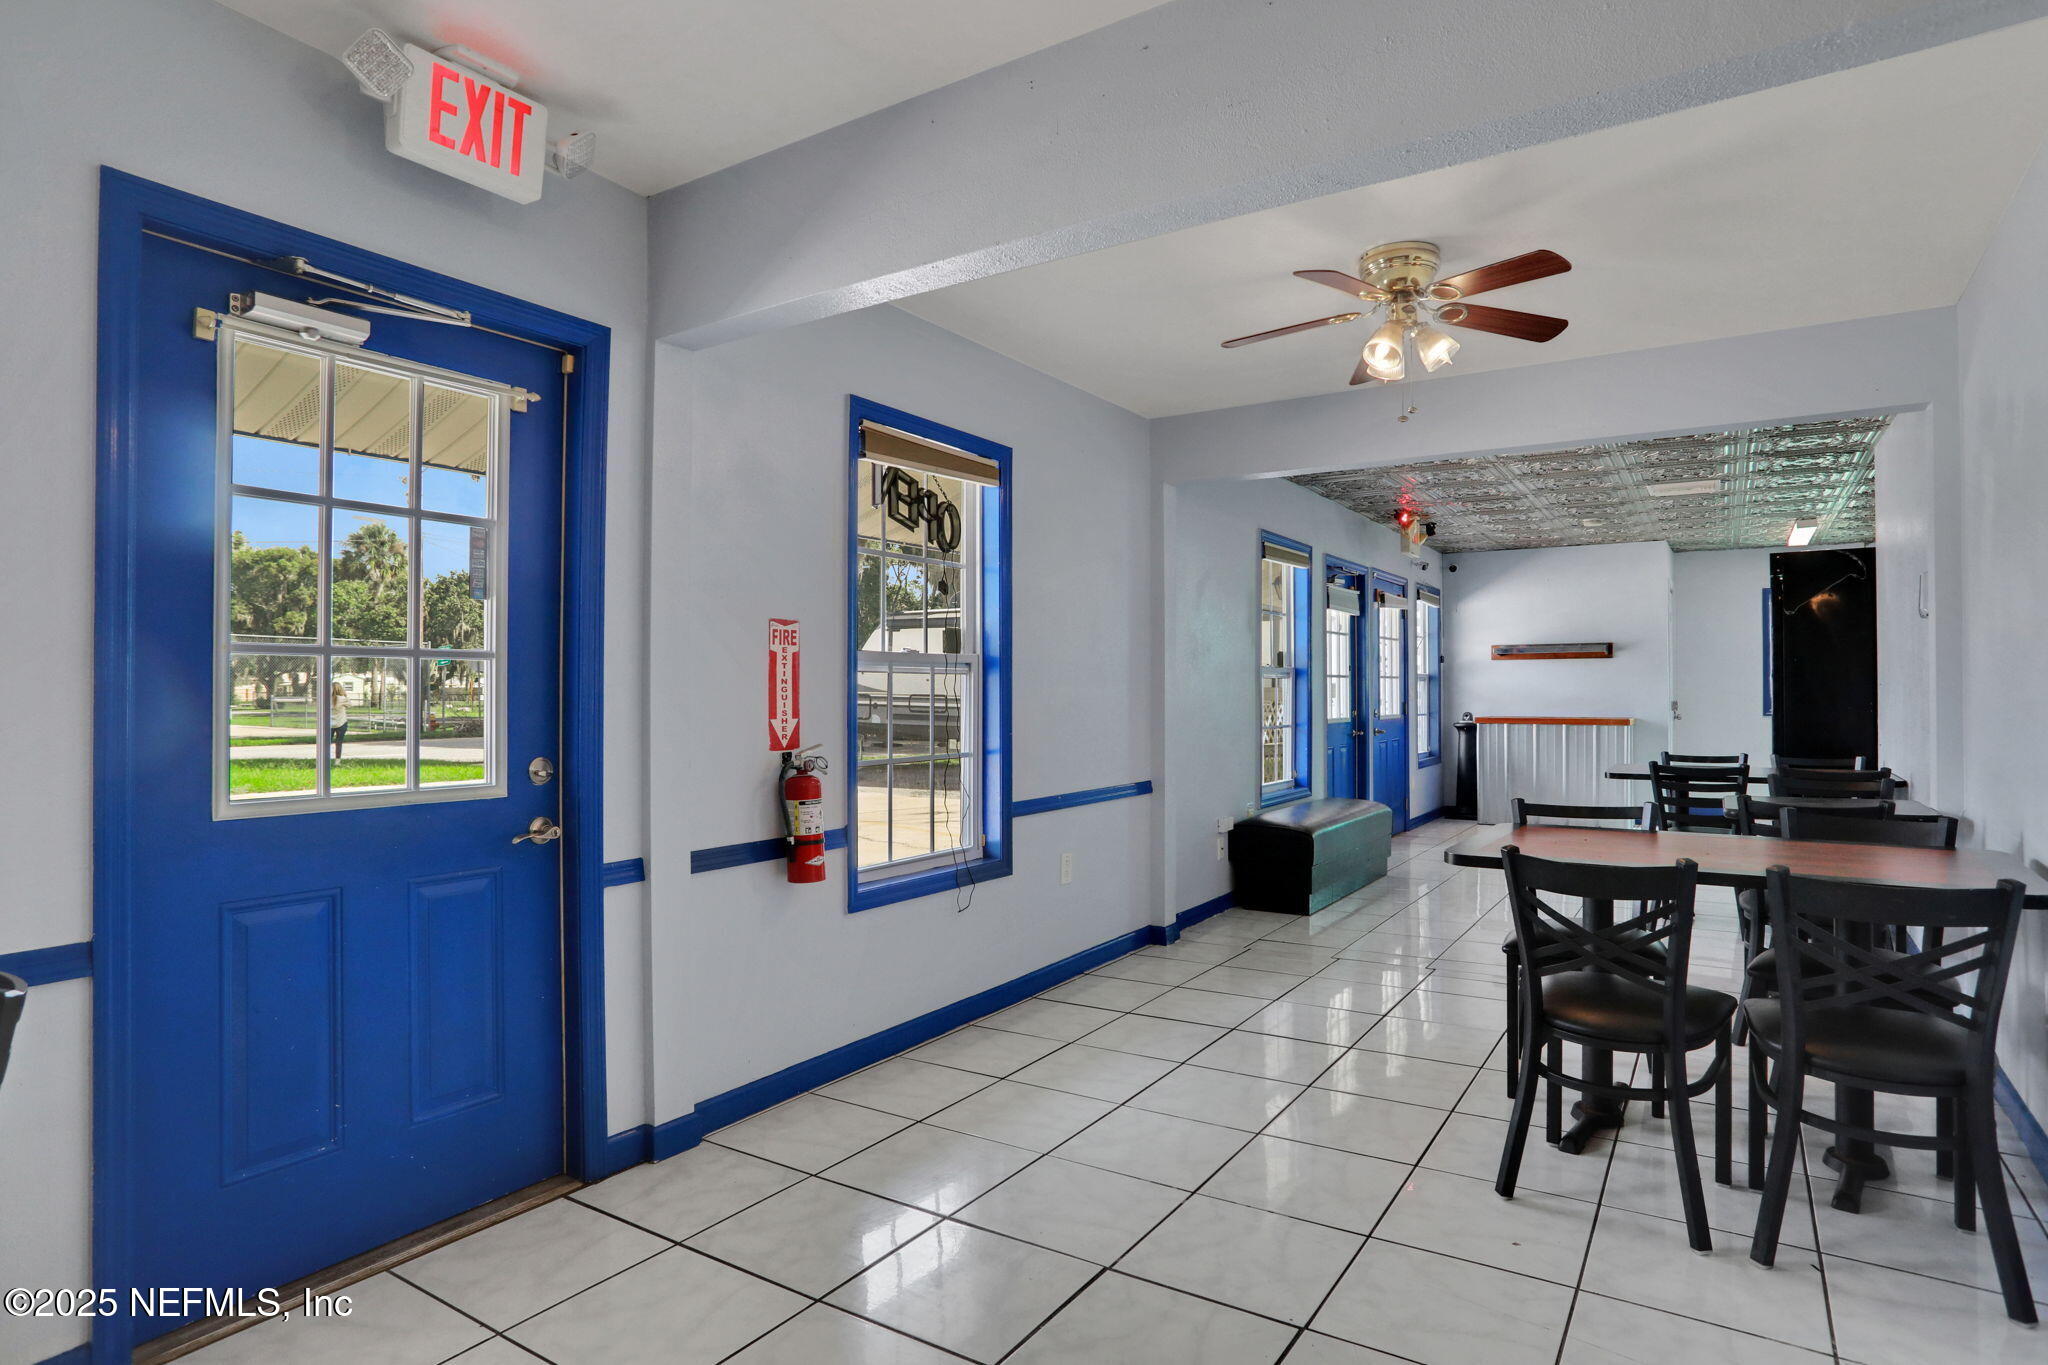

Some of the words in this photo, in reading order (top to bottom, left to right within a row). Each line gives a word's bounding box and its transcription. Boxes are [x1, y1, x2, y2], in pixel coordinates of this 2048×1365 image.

[429, 62, 532, 177] EXIT
[771, 628, 798, 646] FIRE
[781, 646, 789, 741] EXTINGUISHER
